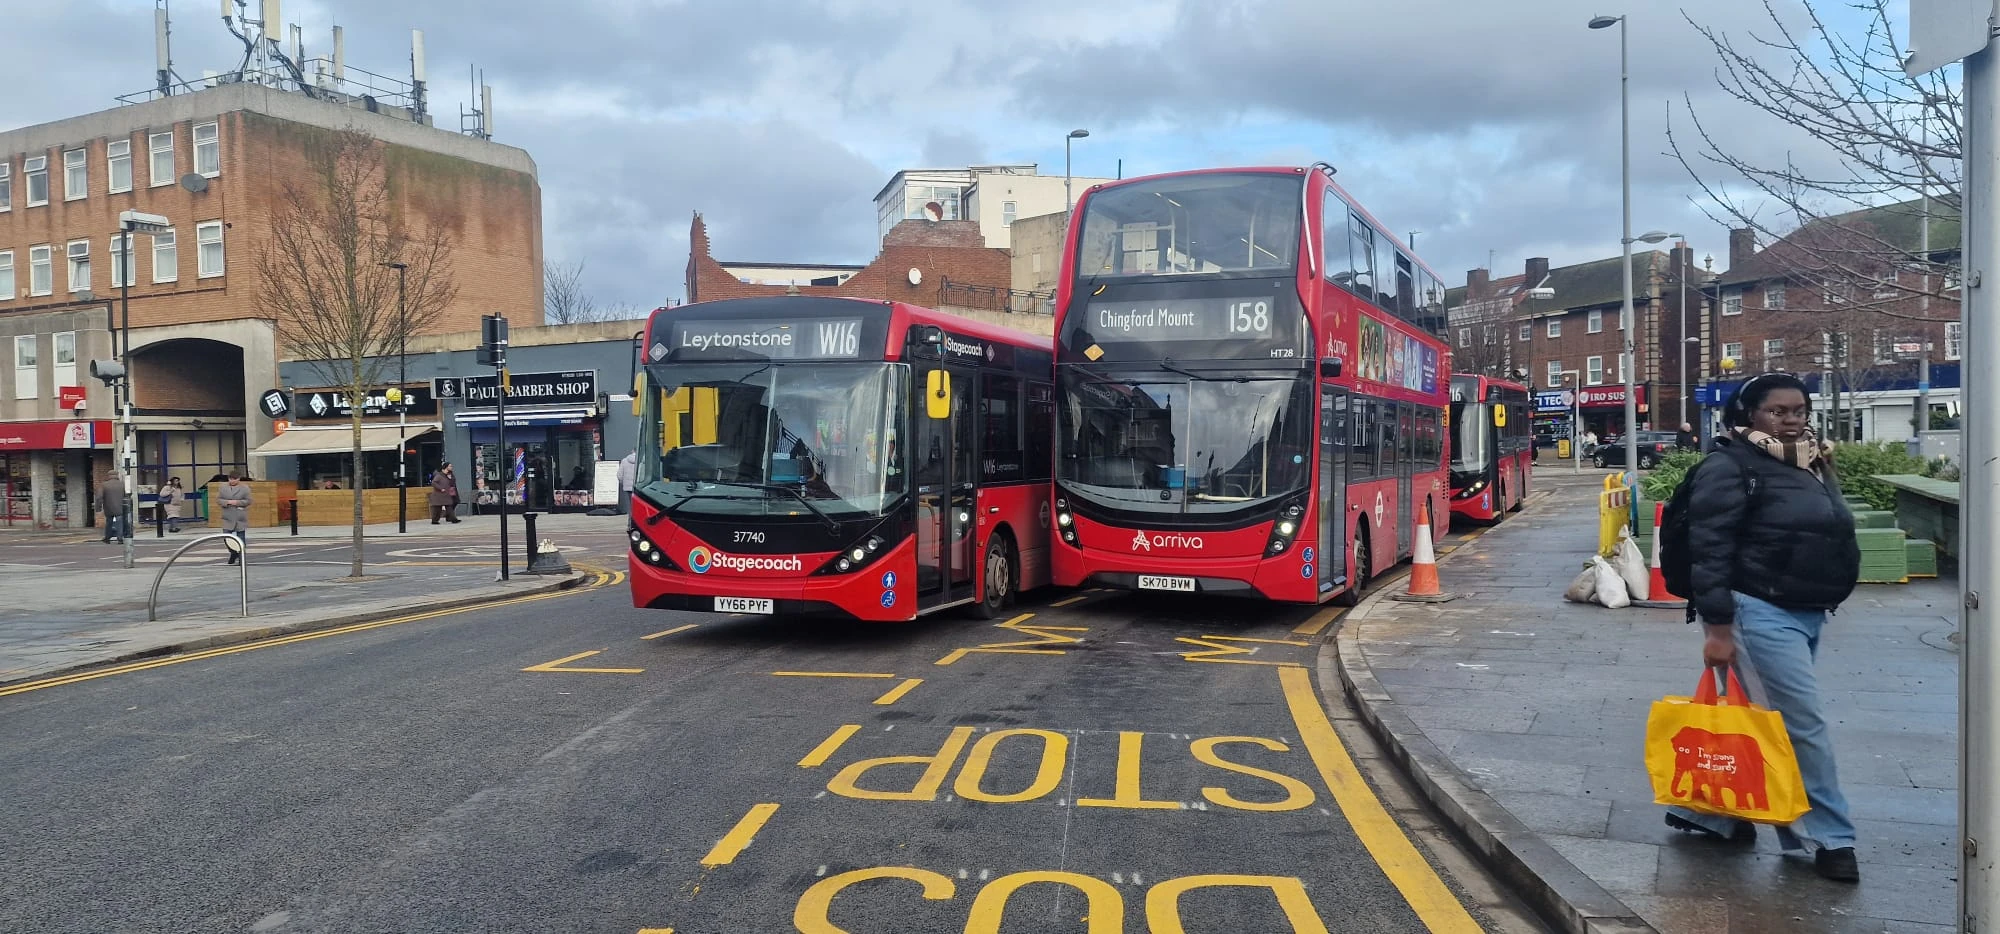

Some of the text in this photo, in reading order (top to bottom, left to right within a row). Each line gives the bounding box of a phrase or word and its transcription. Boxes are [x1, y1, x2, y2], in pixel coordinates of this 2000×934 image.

[1099, 301, 1268, 333] Chingford Mount 158
[682, 322, 857, 355] Leytonstone W16
[946, 336, 983, 357] Stagecoach
[1270, 348, 1294, 358] HT28
[507, 383, 555, 398] BARBER
[556, 381, 590, 396] SHOP
[1449, 386, 1462, 402] 16
[733, 531, 765, 544] 37740
[1153, 532, 1203, 549] arriva
[712, 552, 802, 572] Stagecoach
[1142, 577, 1190, 590] SK70 BVM
[719, 598, 768, 612] YY66 PYF
[826, 726, 1315, 812] STOP
